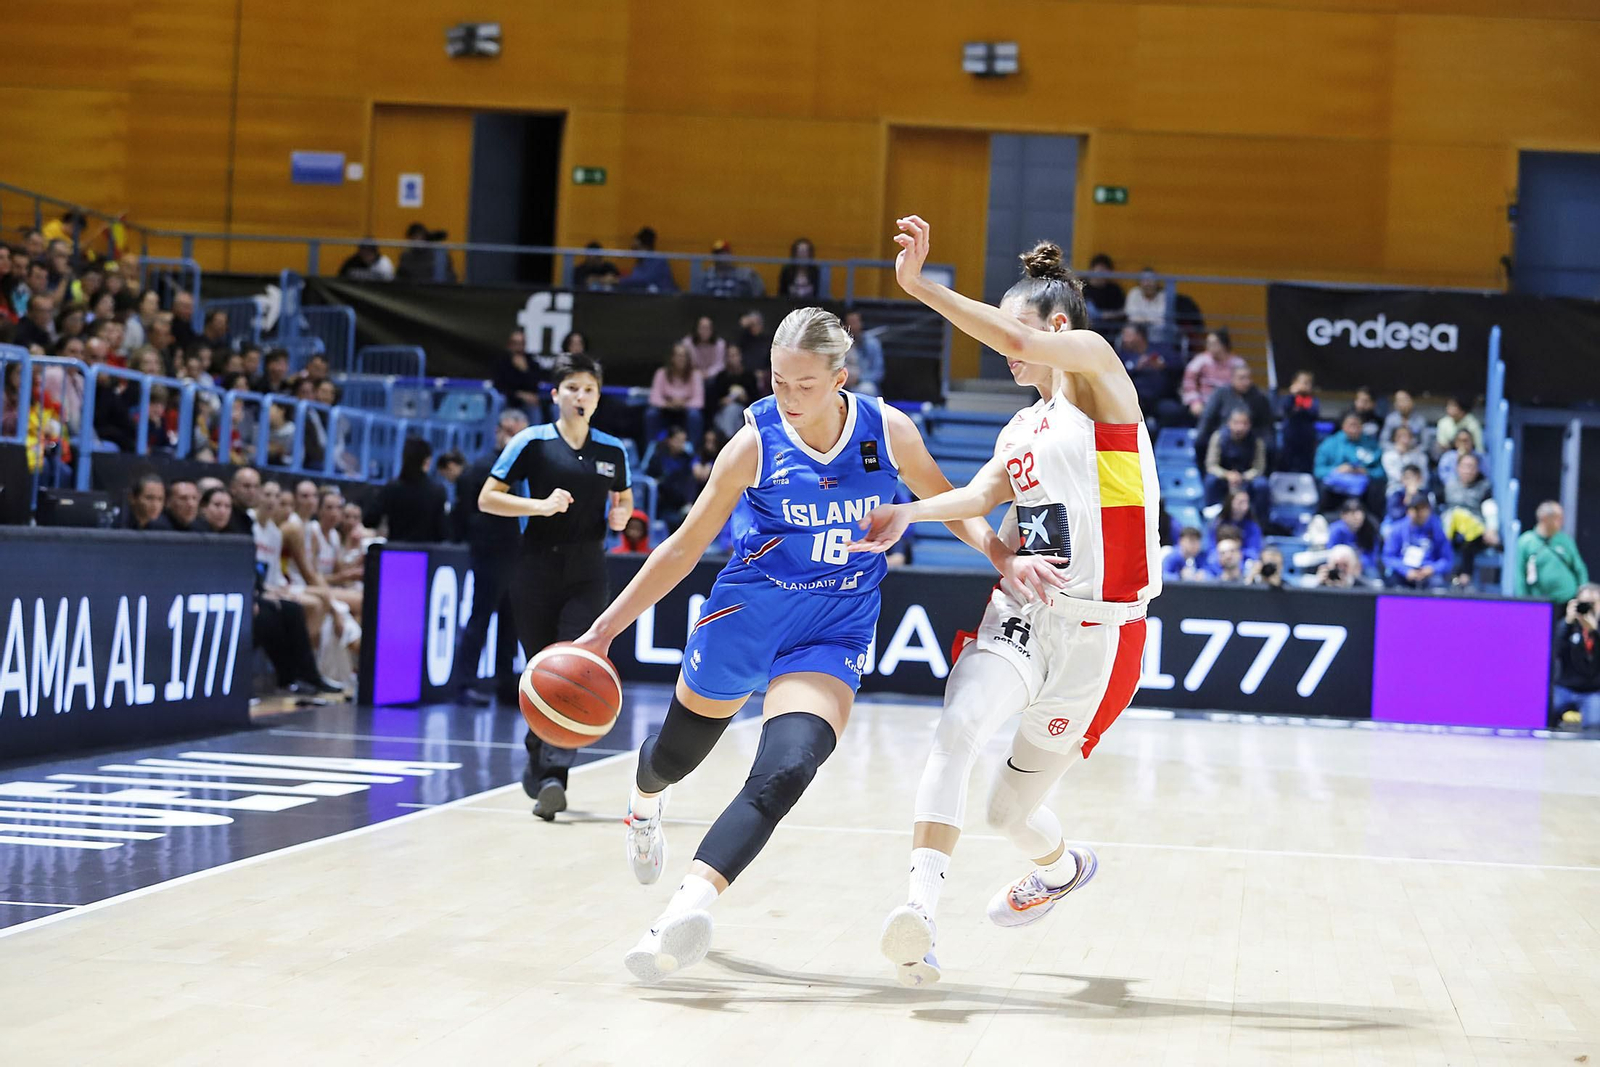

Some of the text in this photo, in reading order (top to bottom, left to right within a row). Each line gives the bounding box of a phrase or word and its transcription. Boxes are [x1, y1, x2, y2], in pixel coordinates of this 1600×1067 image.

[516, 291, 574, 355] fi
[1307, 312, 1459, 352] endesa
[1007, 452, 1040, 492] 22
[781, 495, 880, 527] ÍSLAND
[811, 528, 852, 566] 16
[103, 595, 156, 709] AL
[164, 592, 244, 702] 1777
[1001, 616, 1031, 647] fi
